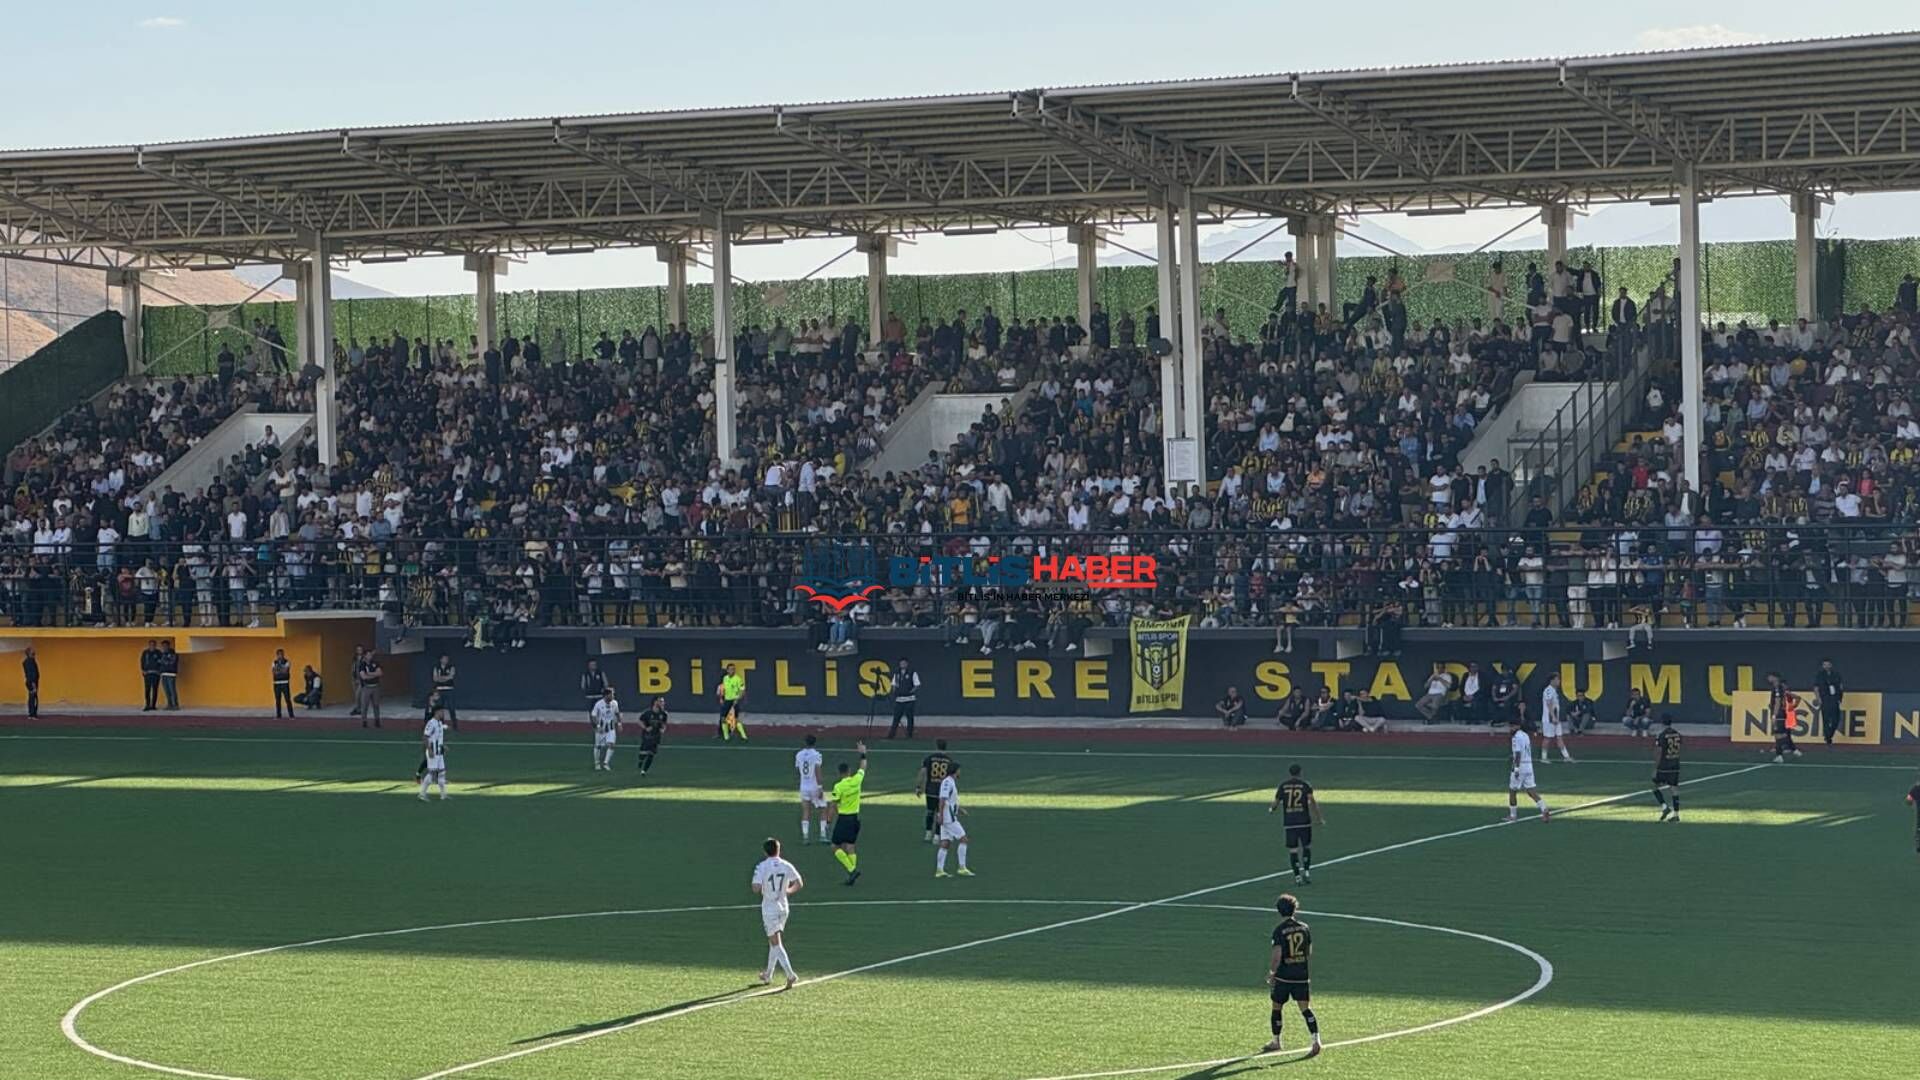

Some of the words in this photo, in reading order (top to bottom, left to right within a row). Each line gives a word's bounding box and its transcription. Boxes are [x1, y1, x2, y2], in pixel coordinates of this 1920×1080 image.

[802, 761, 810, 776] 8
[930, 762, 949, 778] 88
[1284, 789, 1303, 809] 72
[767, 873, 786, 892] 17
[1286, 932, 1304, 957] 12
